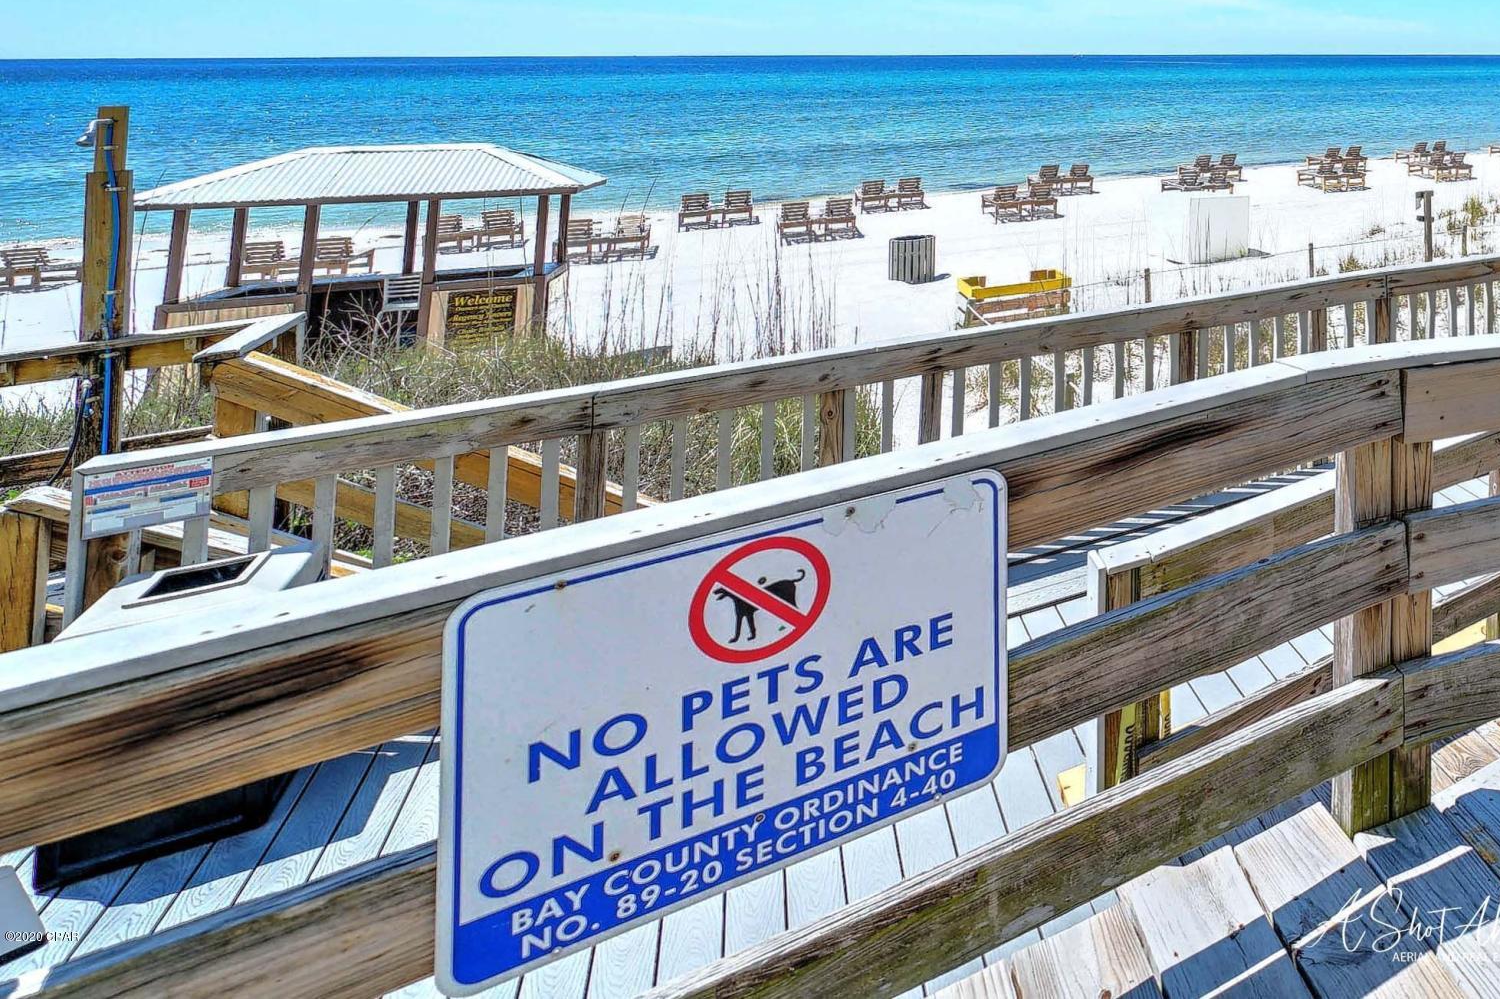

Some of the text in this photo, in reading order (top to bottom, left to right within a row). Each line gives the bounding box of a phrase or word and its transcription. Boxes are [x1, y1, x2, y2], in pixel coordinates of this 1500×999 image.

[454, 295, 513, 306] Welcome
[527, 612, 954, 784] NO PETS ARE
[584, 673, 909, 816] ALLOWED
[479, 686, 985, 898] ON THE BEACH
[510, 743, 964, 936] BAY COUNTY ORDINANCE
[520, 769, 957, 959] NO. 89-20 SECTION 4-40
